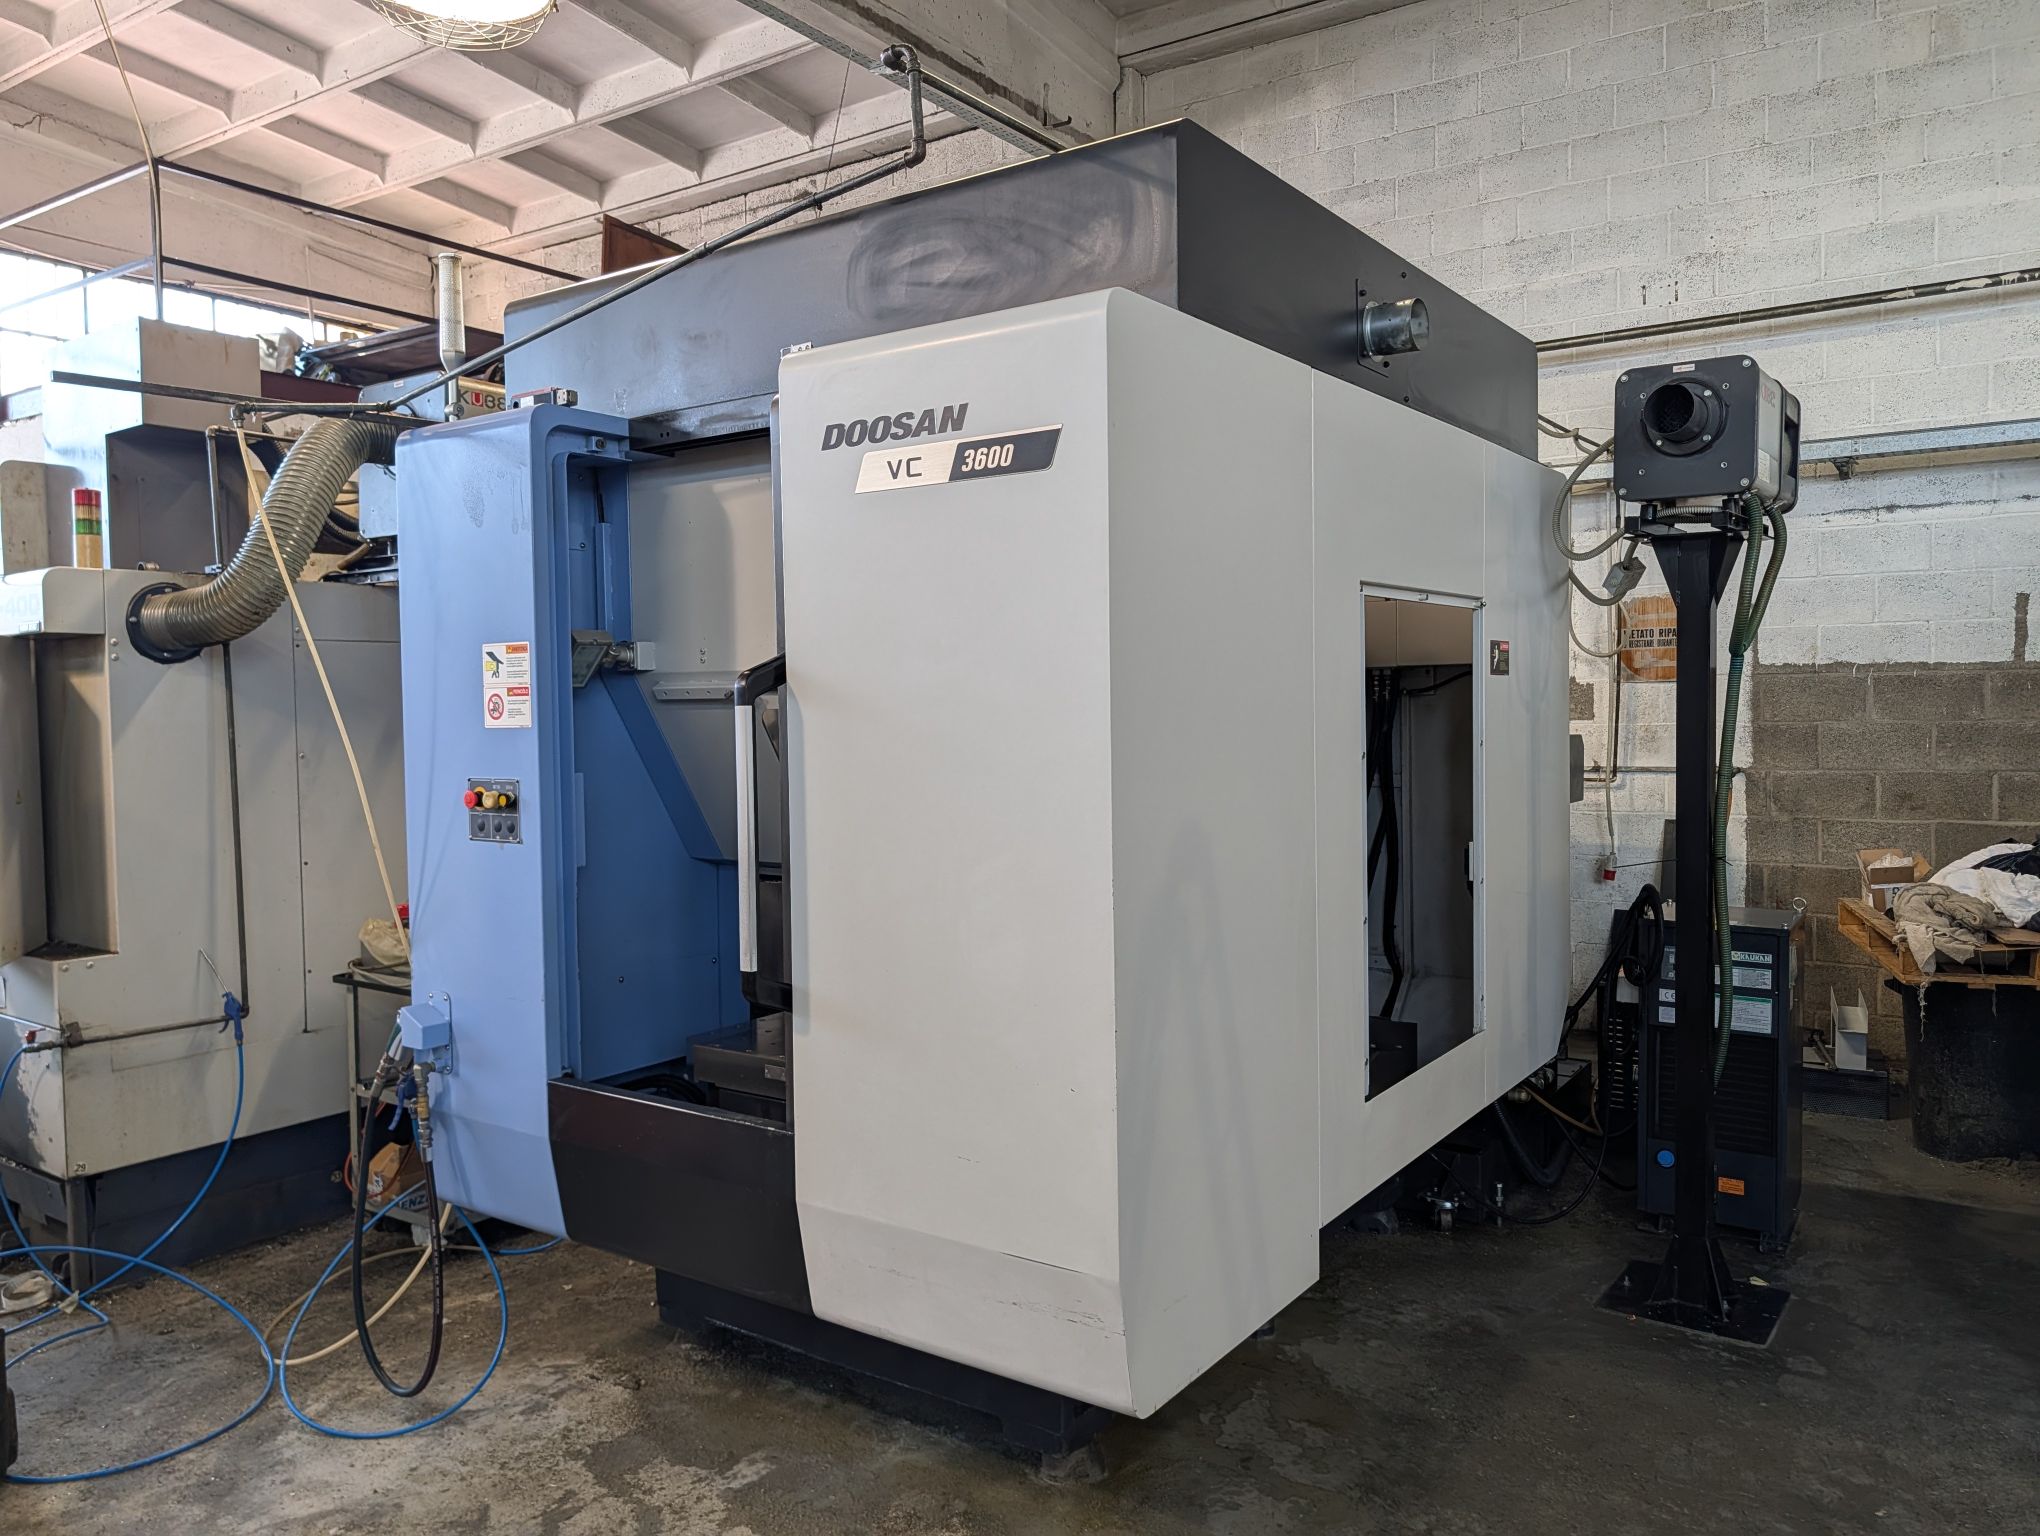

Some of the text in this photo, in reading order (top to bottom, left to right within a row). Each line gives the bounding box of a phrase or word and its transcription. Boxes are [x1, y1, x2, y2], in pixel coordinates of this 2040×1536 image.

[821, 402, 968, 451] DOOSAN
[887, 443, 1014, 480] VC 3600
